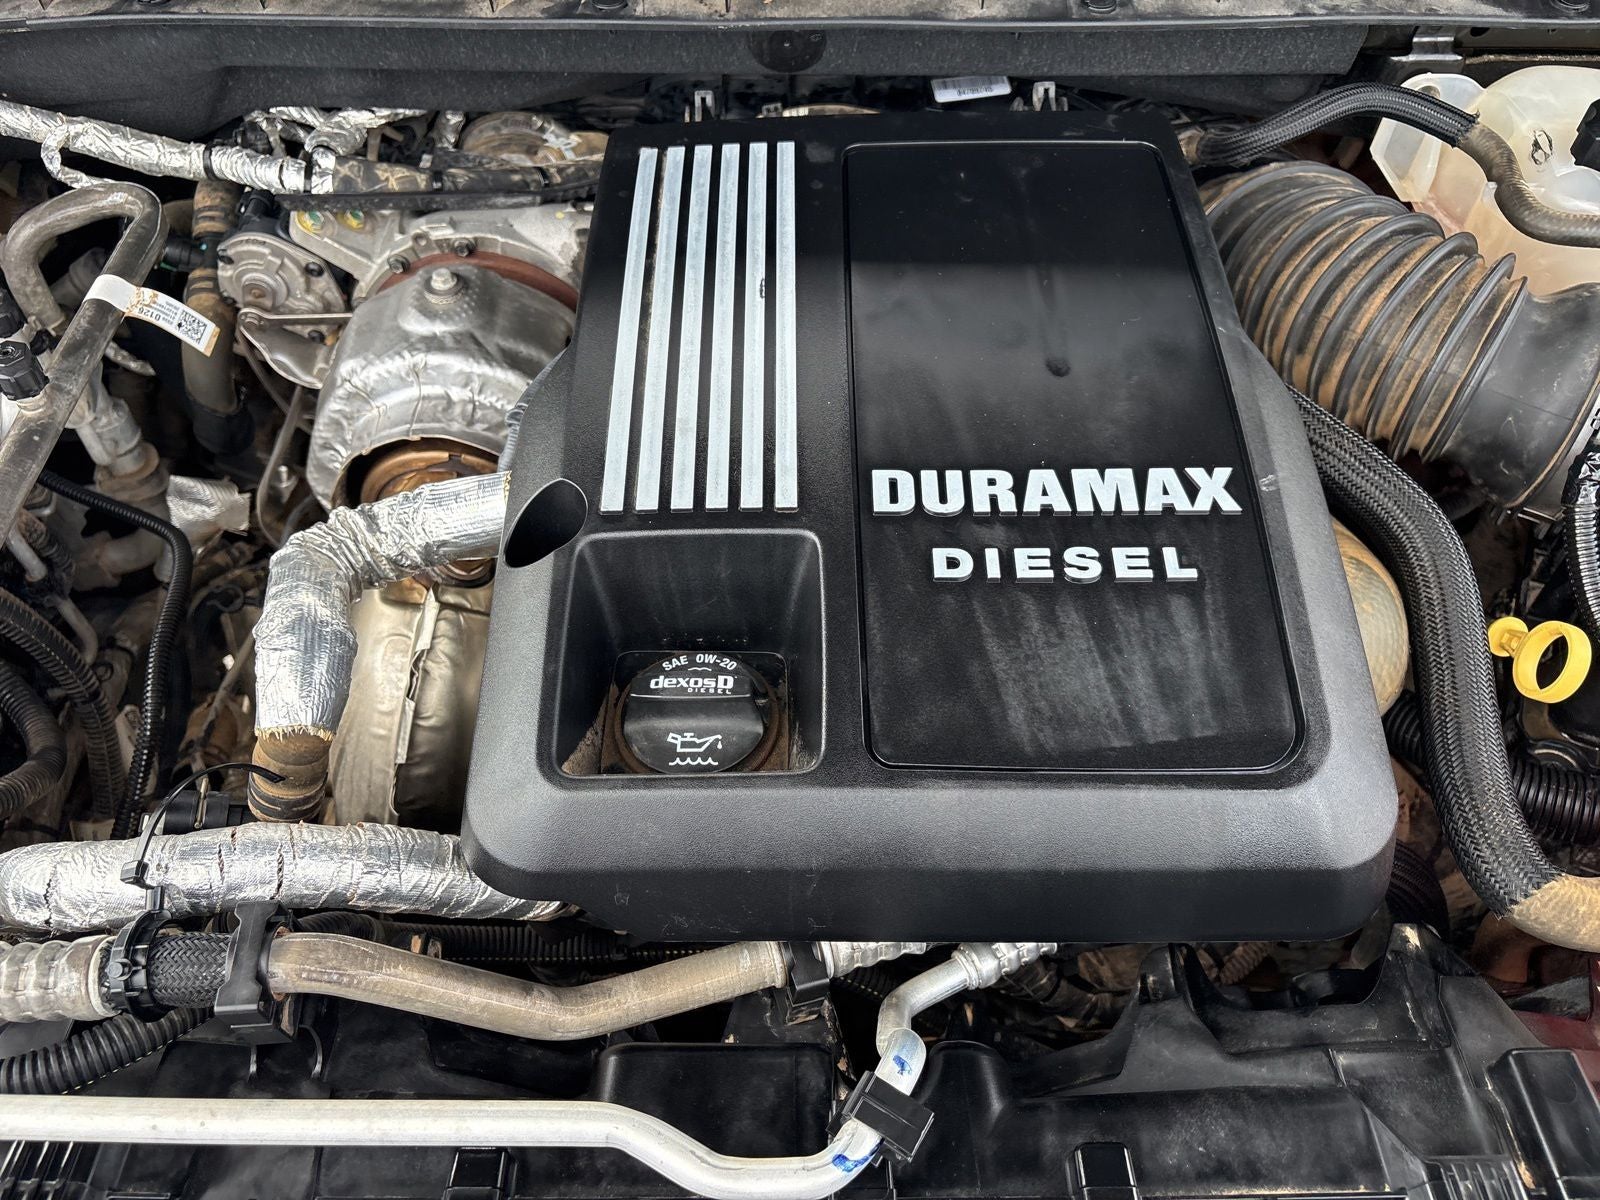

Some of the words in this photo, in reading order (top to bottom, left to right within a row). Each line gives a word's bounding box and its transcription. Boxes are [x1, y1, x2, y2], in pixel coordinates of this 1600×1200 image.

[138, 307, 161, 321] 0126
[871, 467, 1243, 514] DURAMAX
[932, 546, 1199, 581] DIESEL
[662, 655, 689, 671] SAE
[696, 653, 738, 671] 0W-20
[650, 675, 734, 689] dexosD
